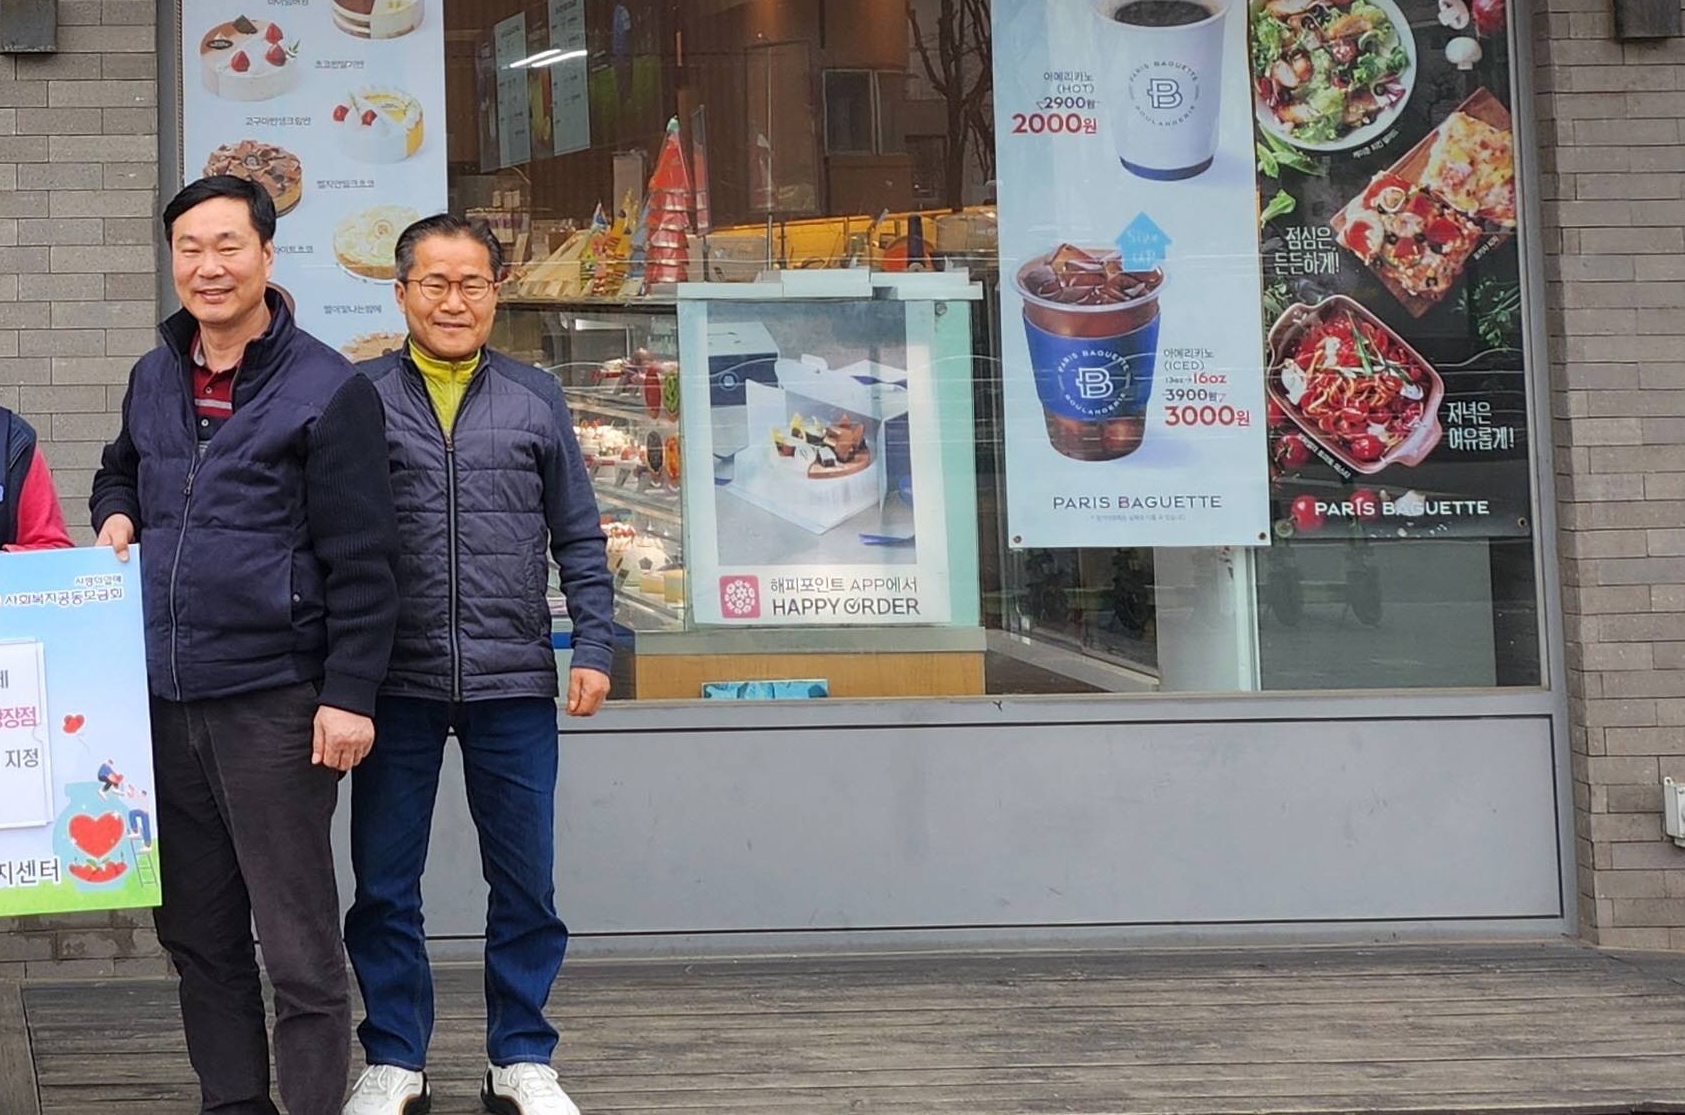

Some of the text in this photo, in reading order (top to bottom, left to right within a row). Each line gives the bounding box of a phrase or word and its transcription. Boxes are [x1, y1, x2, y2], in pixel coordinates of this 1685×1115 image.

[1043, 71, 1094, 83] 아메리카노
[1057, 83, 1095, 95] (HOT)
[1043, 96, 1096, 110] 2900원
[1011, 112, 1097, 135] 2000원
[1273, 253, 1340, 275] 든든하게!
[1081, 349, 1130, 373] BAGUETTE
[1163, 347, 1214, 359] 아메리카노
[1163, 359, 1205, 371] (ICED)
[1193, 372, 1227, 385] 16oz
[1165, 389, 1218, 402] 3900원
[1164, 404, 1251, 427] 3000원
[1447, 401, 1492, 425] 저녁은
[1448, 427, 1515, 451] 여유롭게!
[1052, 494, 1223, 510] PARIS BAGUETTE
[1314, 500, 1375, 516] PARIS
[770, 576, 918, 594] 해피포인트 APP에서
[4, 587, 123, 607] 사회복지공동모금회
[772, 596, 921, 616] HAPPY ORDER
[4, 747, 40, 769] 지정
